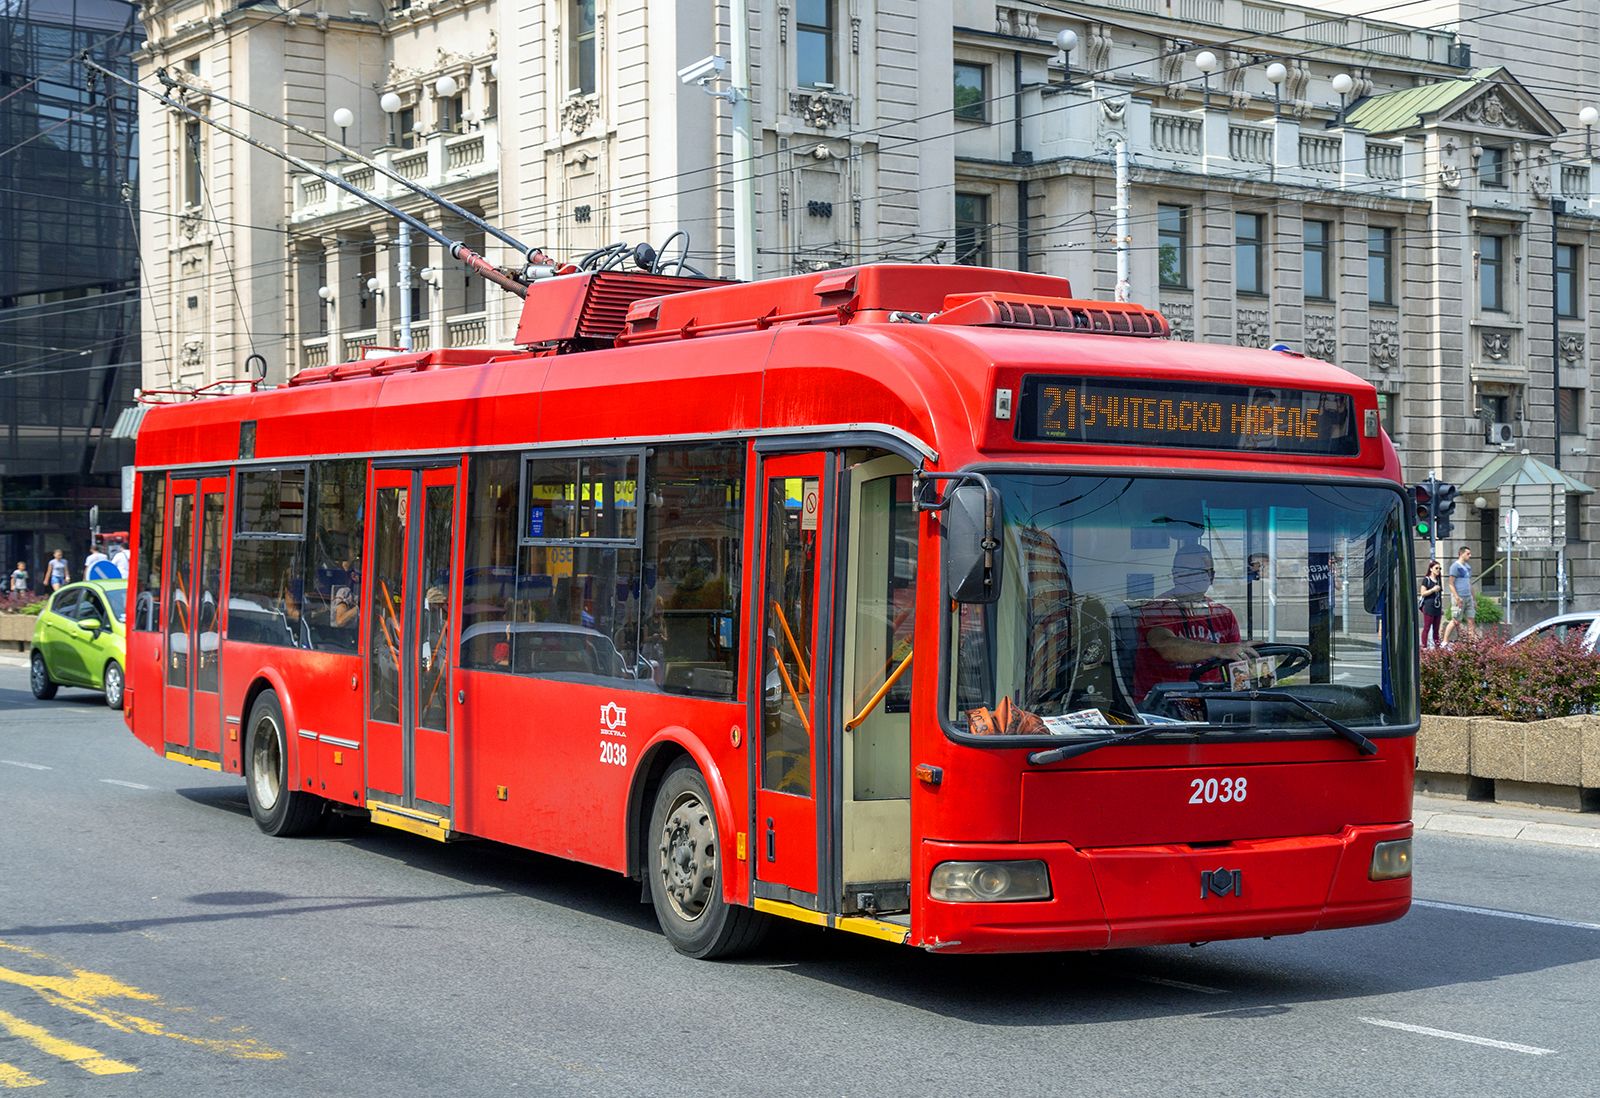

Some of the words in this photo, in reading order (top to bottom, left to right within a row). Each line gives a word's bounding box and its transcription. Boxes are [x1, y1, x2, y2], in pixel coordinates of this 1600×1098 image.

[1043, 387, 1076, 430] 21
[1080, 394, 1221, 433] УЧИТЕЉСКО
[1231, 403, 1320, 438] НАСЕЉЕ
[599, 740, 627, 767] 2038
[1188, 777, 1248, 805] 2038
